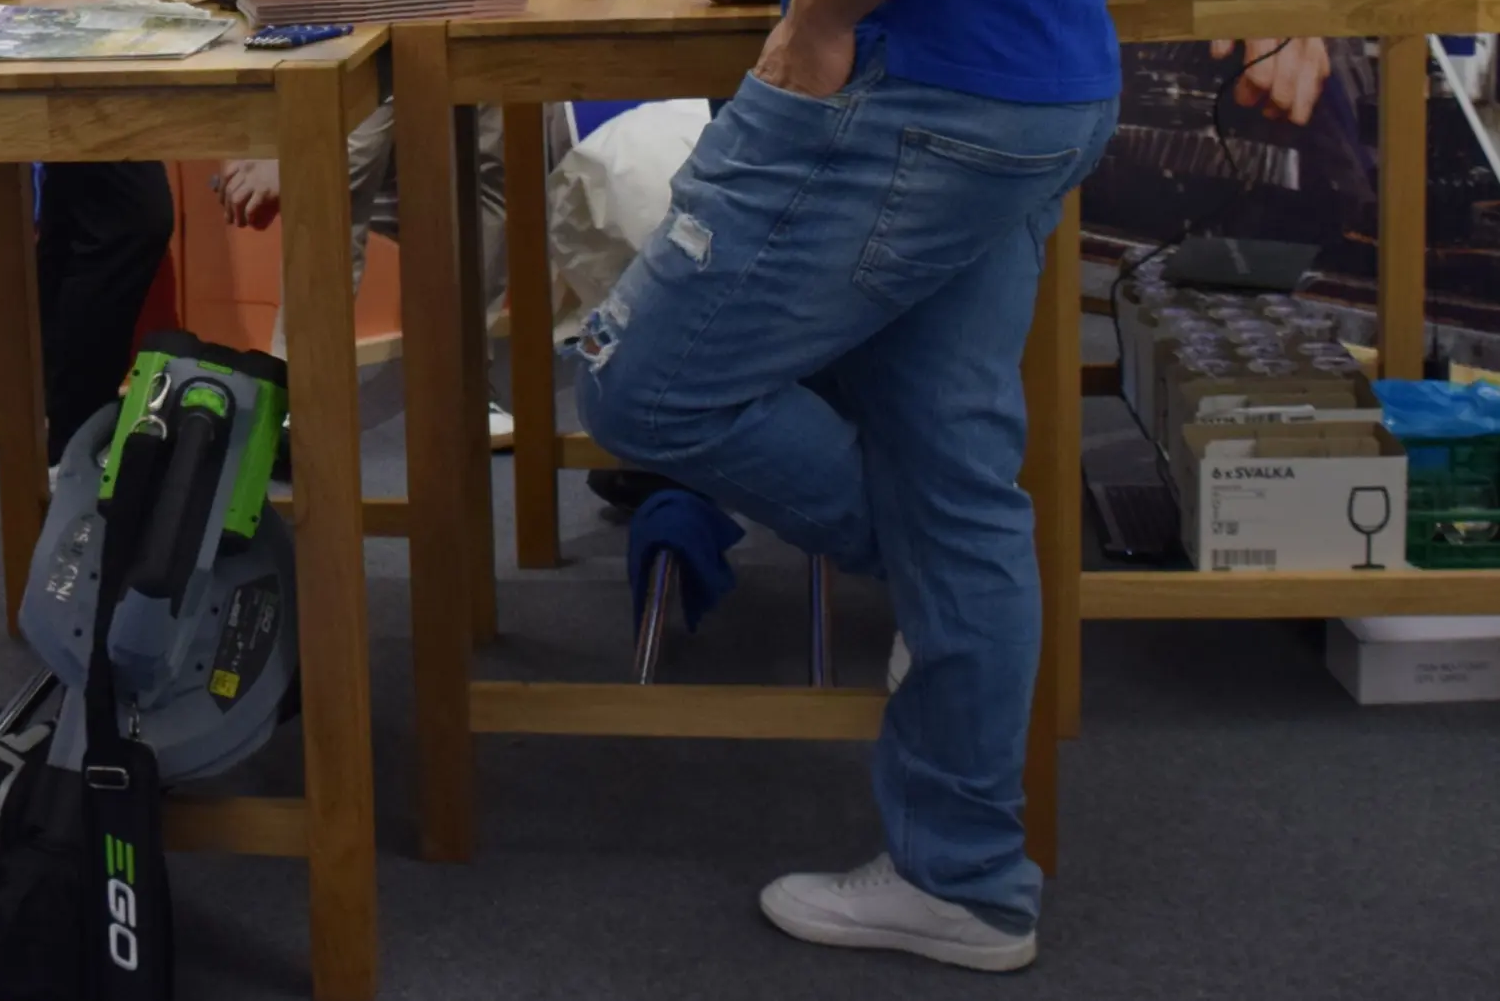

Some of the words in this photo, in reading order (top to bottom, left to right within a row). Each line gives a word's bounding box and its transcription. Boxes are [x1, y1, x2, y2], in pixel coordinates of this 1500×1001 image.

[1211, 466, 1222, 480] 6
[1234, 465, 1296, 480] SVALKA
[104, 832, 138, 971] EGO
